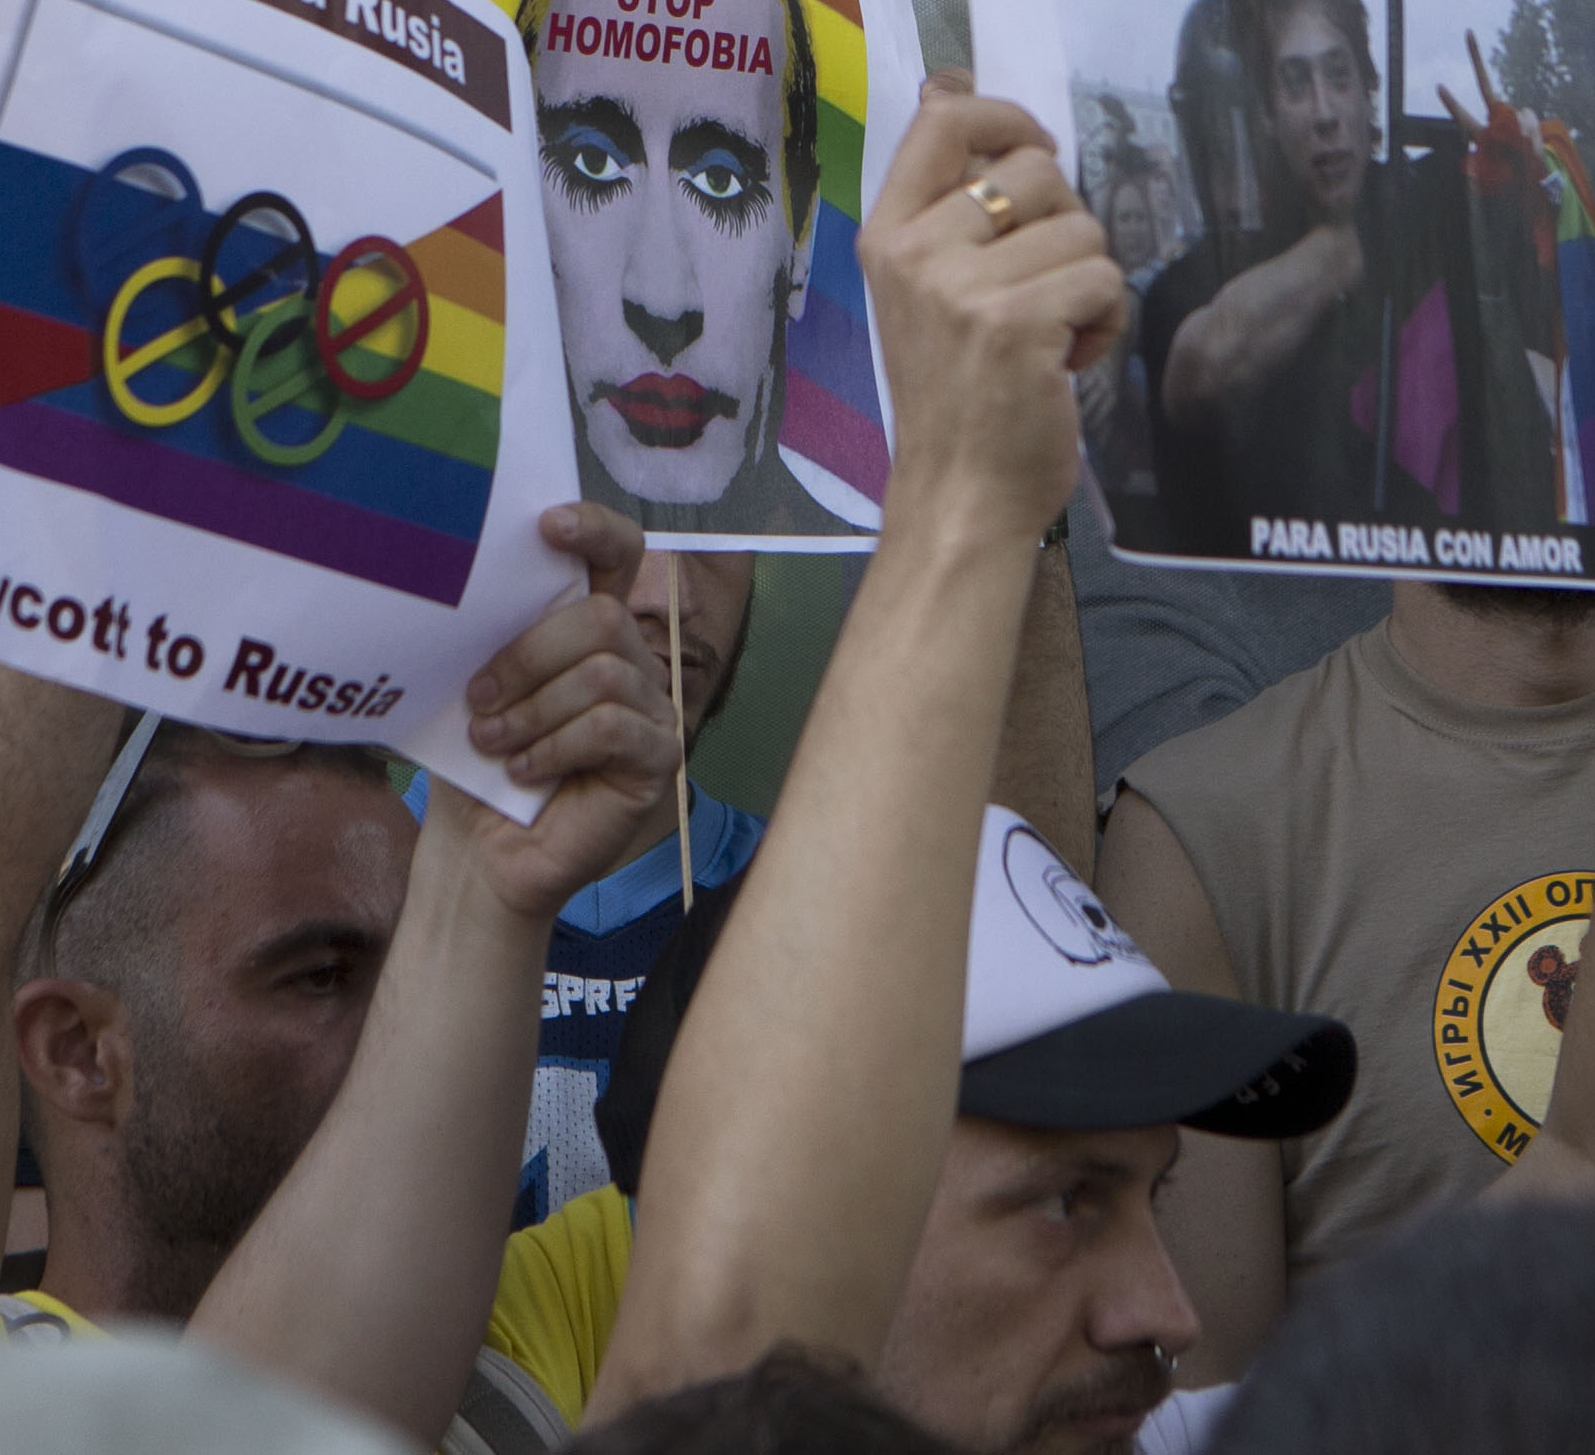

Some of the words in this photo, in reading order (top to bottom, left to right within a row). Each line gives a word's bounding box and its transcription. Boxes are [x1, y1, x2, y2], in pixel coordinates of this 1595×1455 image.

[547, 12, 774, 76] HOMOFOBIA
[1251, 516, 1333, 558] PARA
[1337, 522, 1430, 564] RUSIA
[1434, 529, 1493, 568] CON
[1499, 534, 1583, 573] AMOR
[145, 614, 205, 678] to
[224, 637, 404, 717] Russia
[1442, 979, 1484, 1097] ИГРЫ
